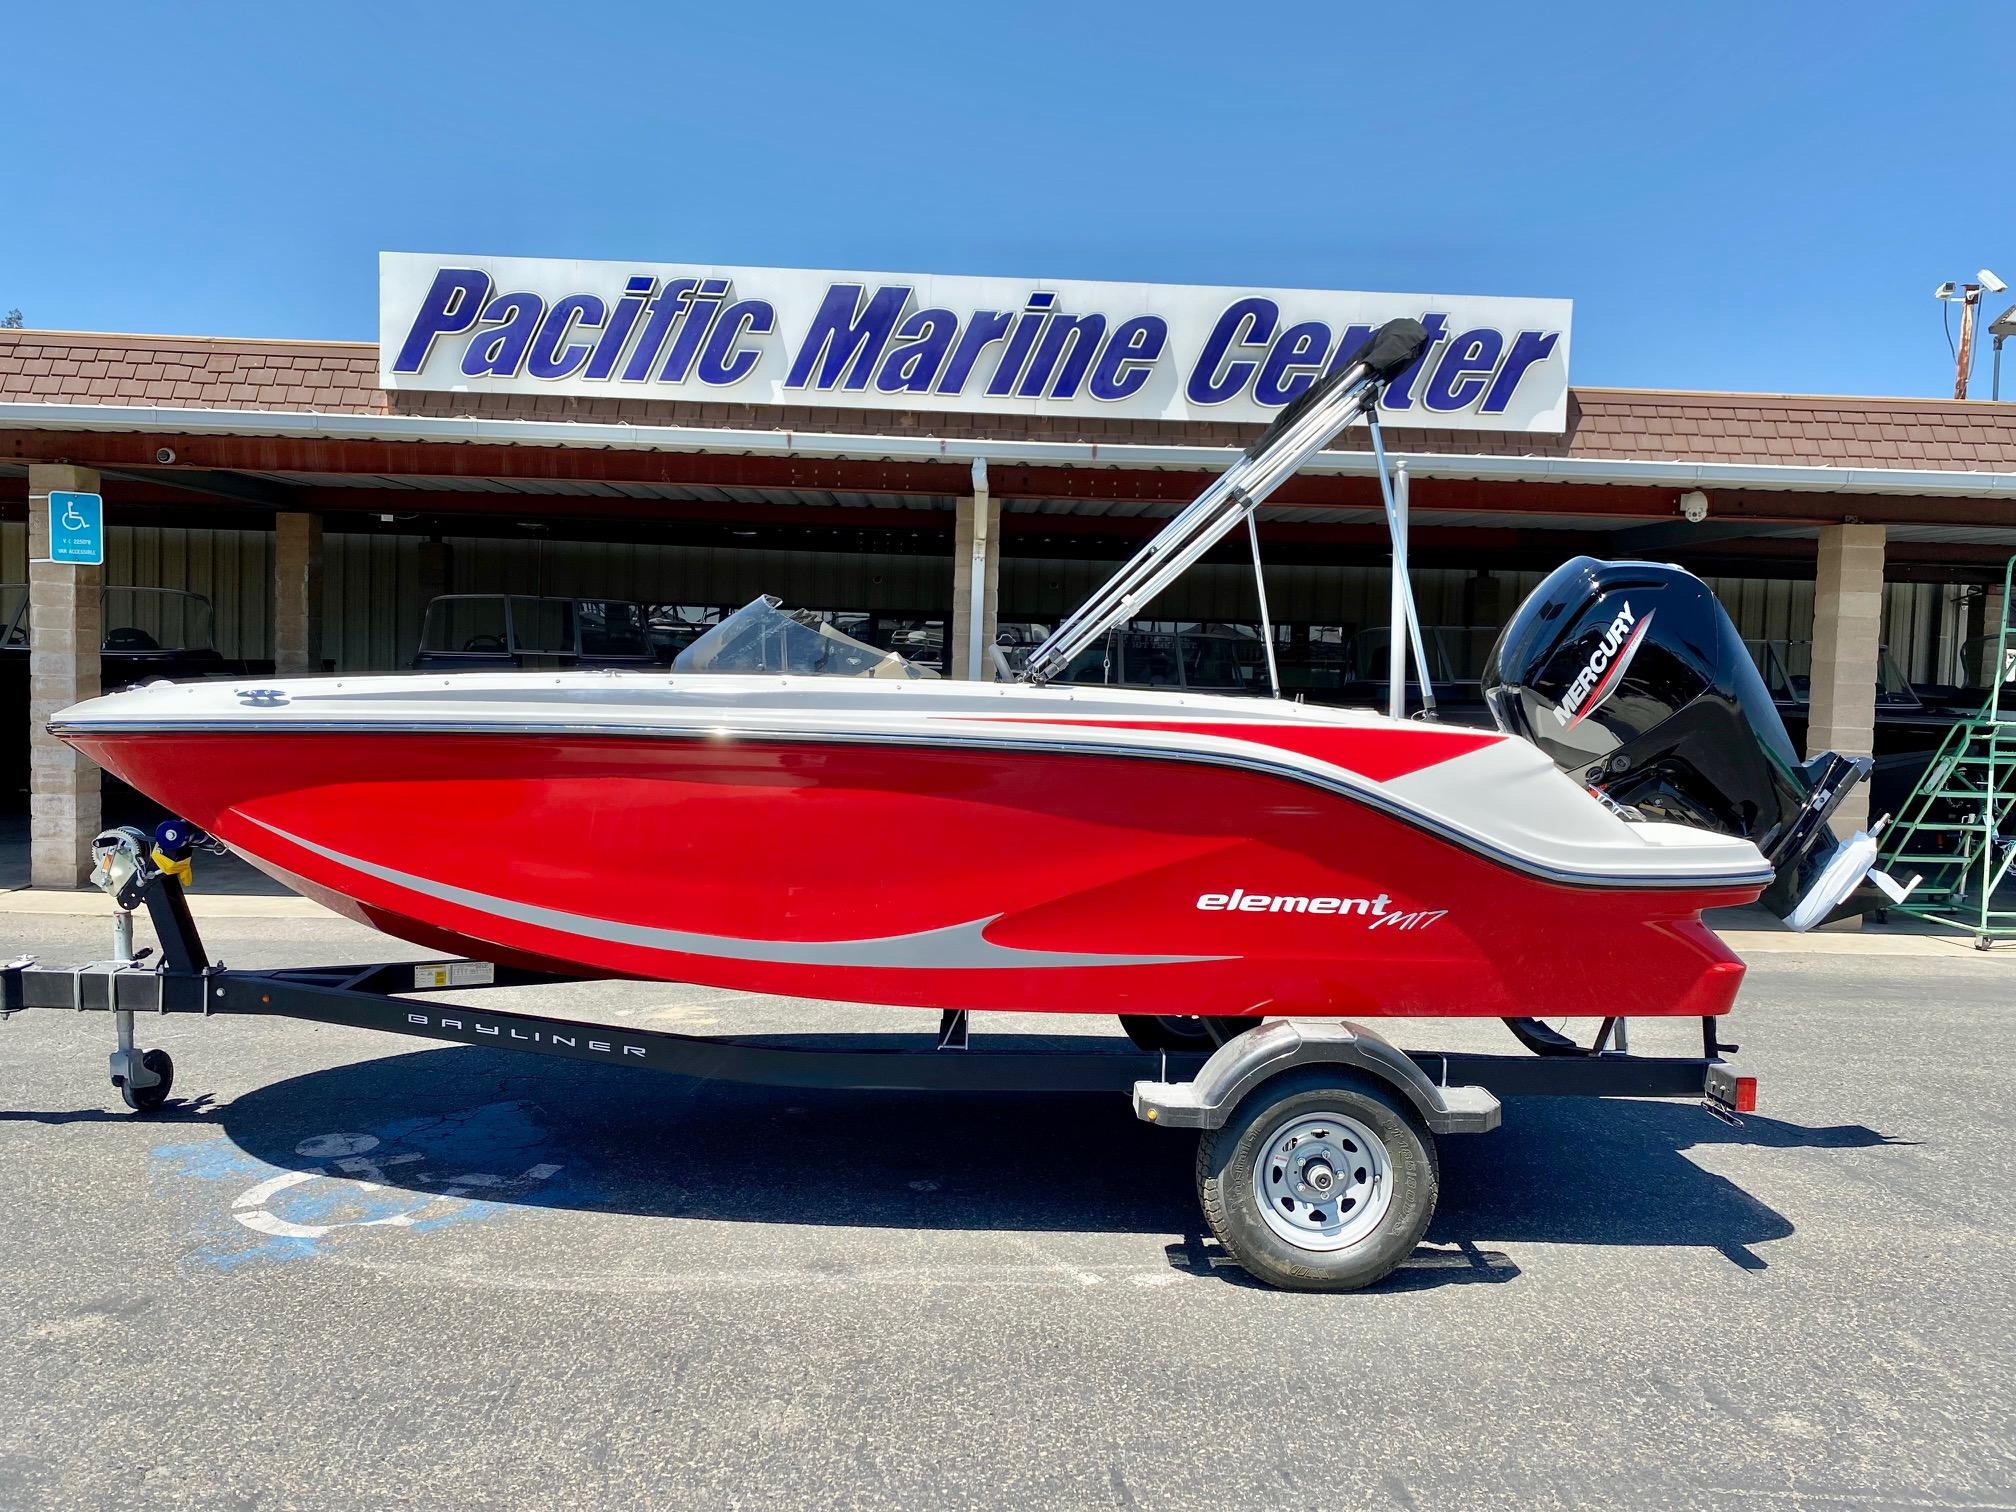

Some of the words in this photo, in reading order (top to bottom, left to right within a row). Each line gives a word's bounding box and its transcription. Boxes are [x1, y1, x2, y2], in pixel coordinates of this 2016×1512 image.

[391, 265, 778, 388] Pacific
[782, 282, 1170, 403] Marine
[1553, 600, 1636, 727] MERCURY
[1196, 888, 1393, 916] element
[1368, 909, 1449, 931] M17
[407, 1012, 647, 1058] BAYLINER
